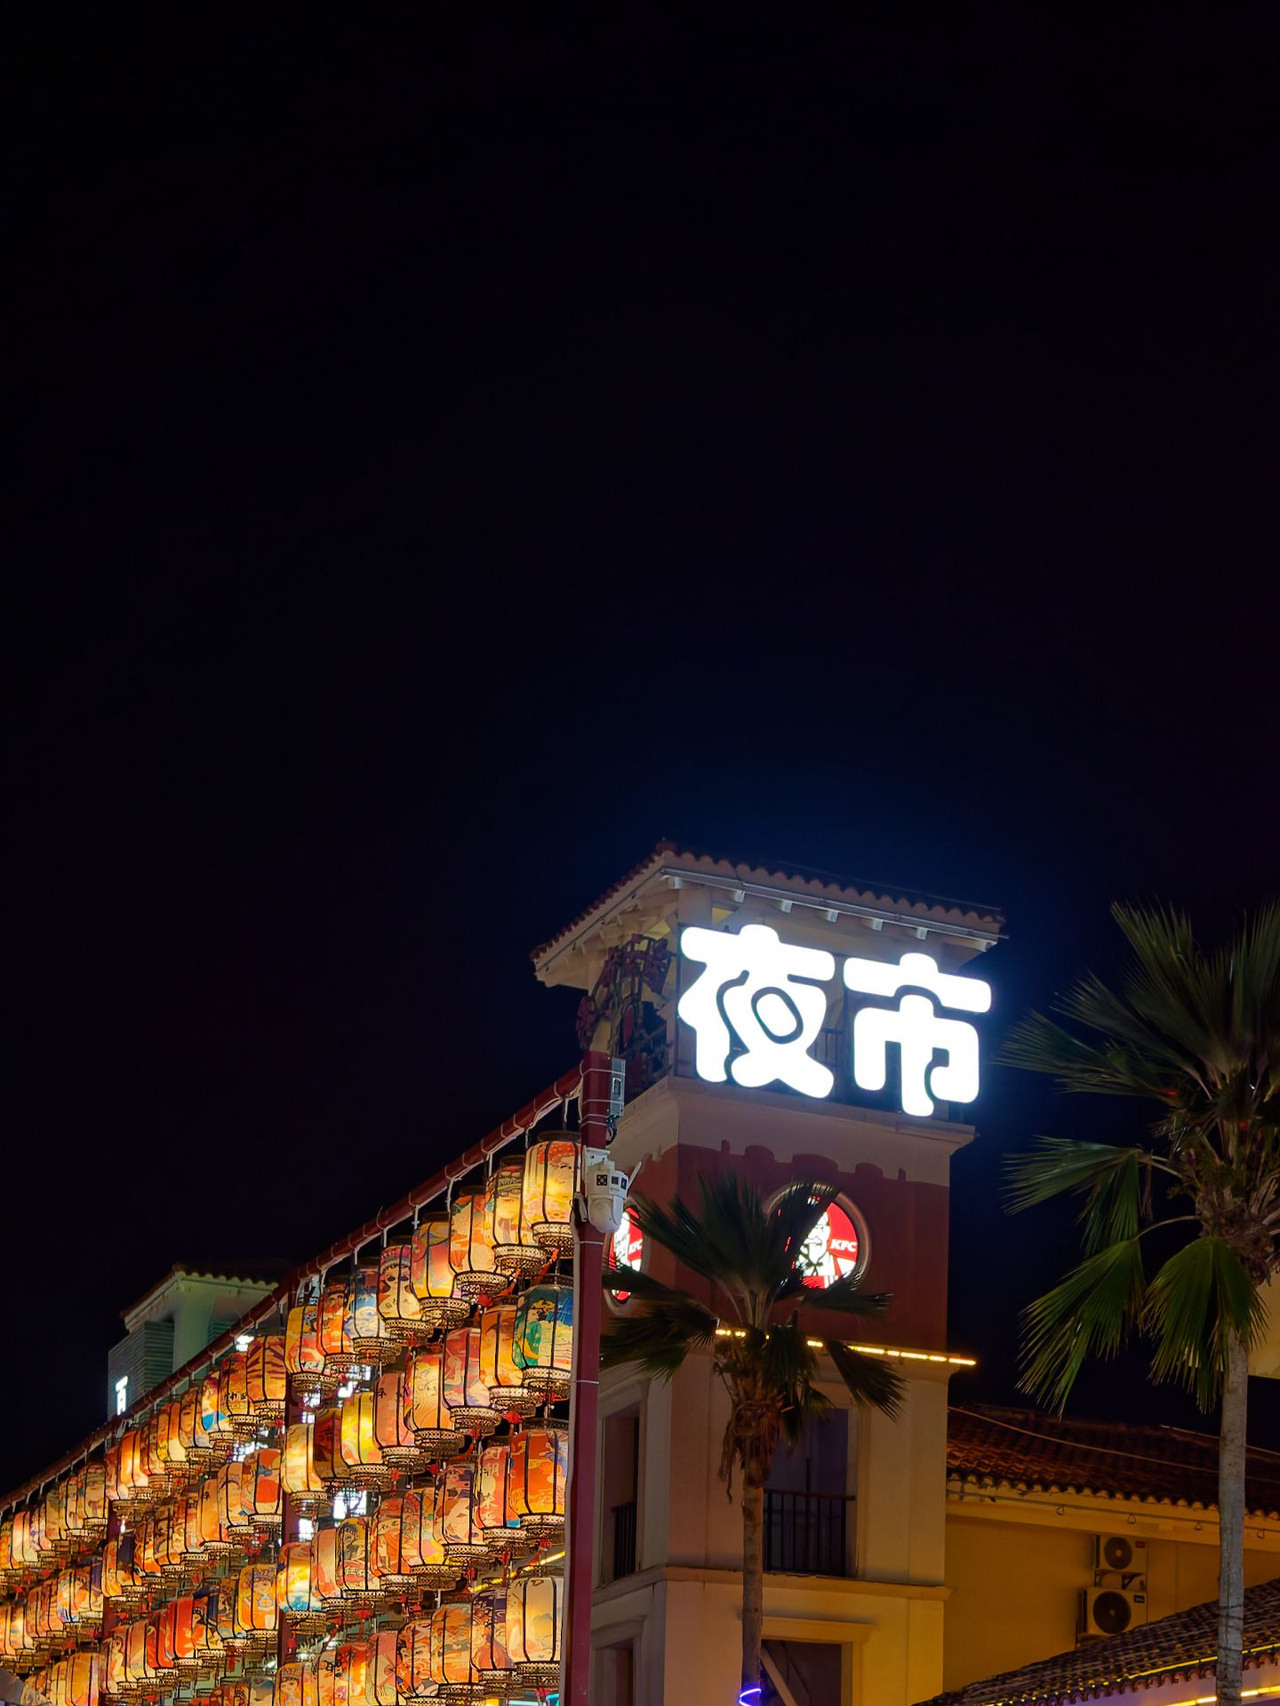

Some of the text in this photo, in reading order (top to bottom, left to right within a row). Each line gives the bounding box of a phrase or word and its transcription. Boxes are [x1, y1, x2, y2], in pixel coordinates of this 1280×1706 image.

[677, 923, 993, 1118] 夜市
[628, 1238, 644, 1255] KFC
[829, 1238, 858, 1253] KFC
